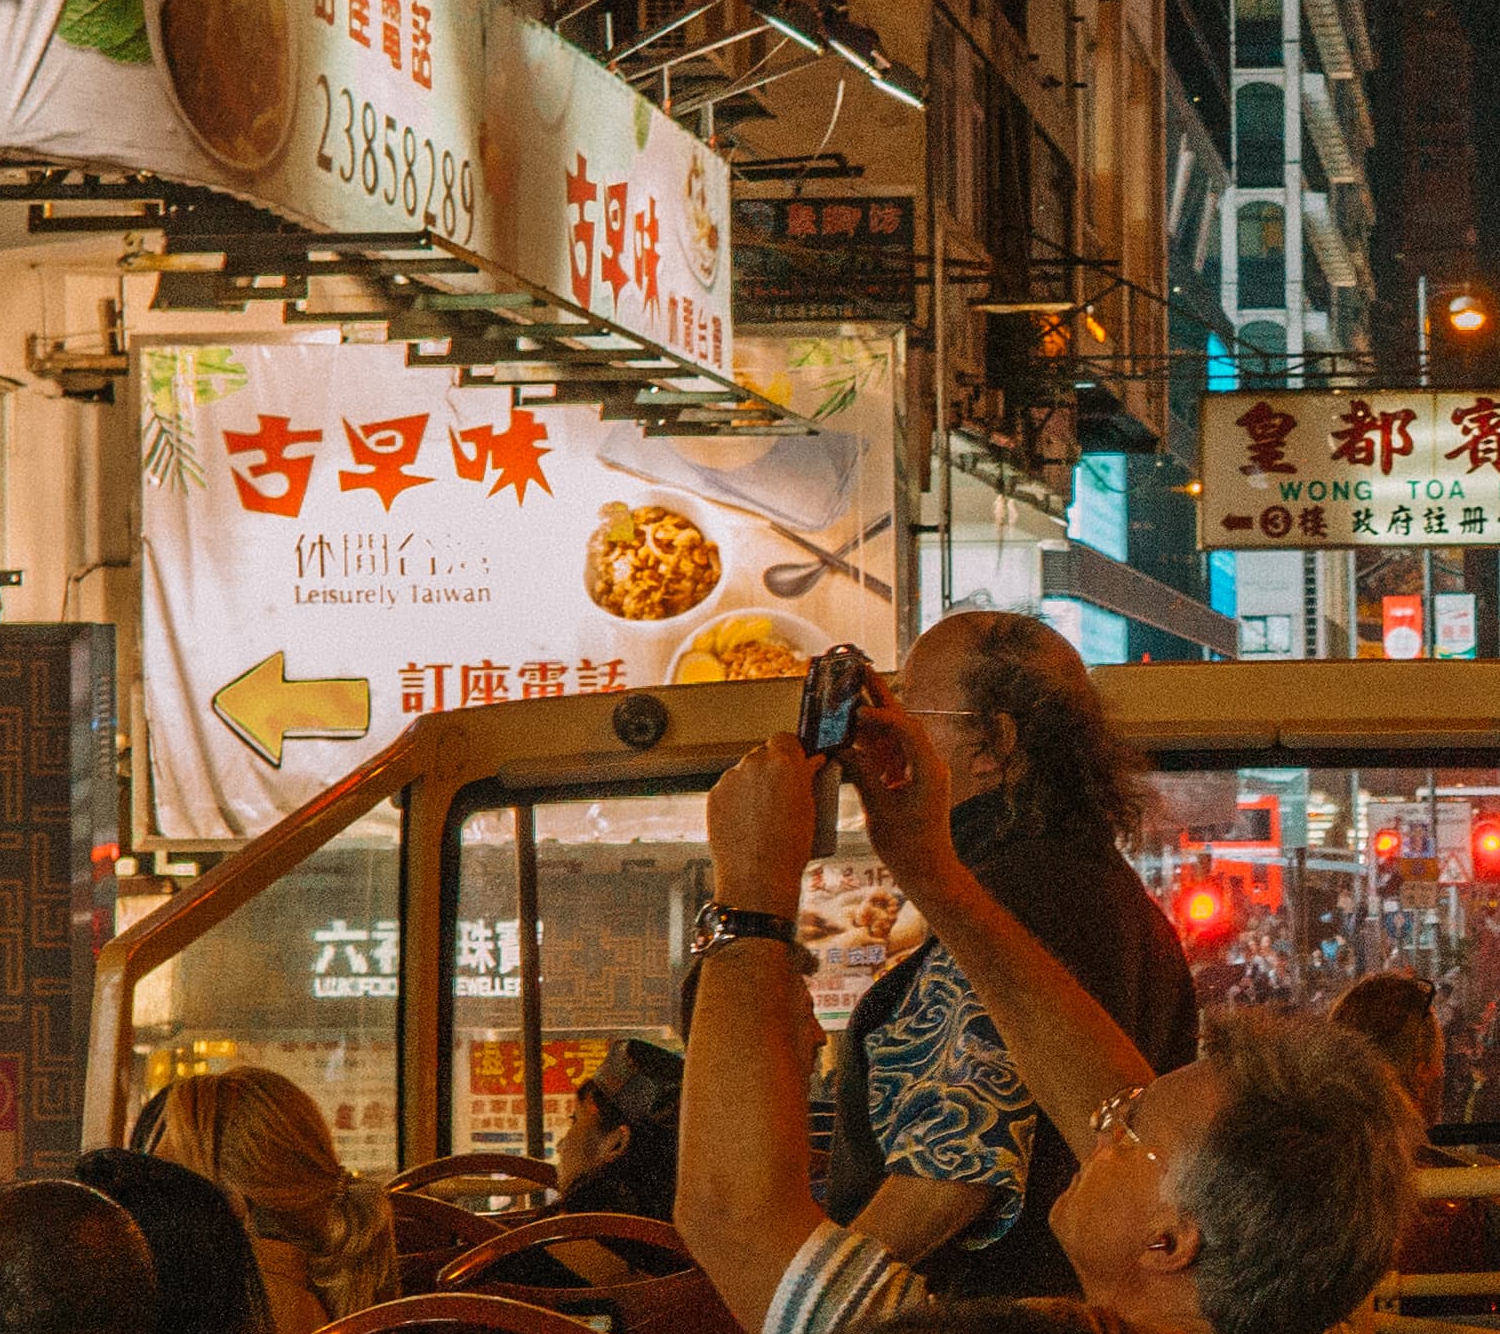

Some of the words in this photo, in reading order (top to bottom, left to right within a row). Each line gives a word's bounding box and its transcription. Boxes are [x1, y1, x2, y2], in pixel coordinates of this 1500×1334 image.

[316, 73, 475, 246] 23858289
[566, 151, 662, 331] 古早味
[222, 407, 556, 520] 古早味
[1279, 480, 1374, 503] WONG
[1409, 479, 1466, 501] TOA
[294, 583, 397, 610] Leisurely
